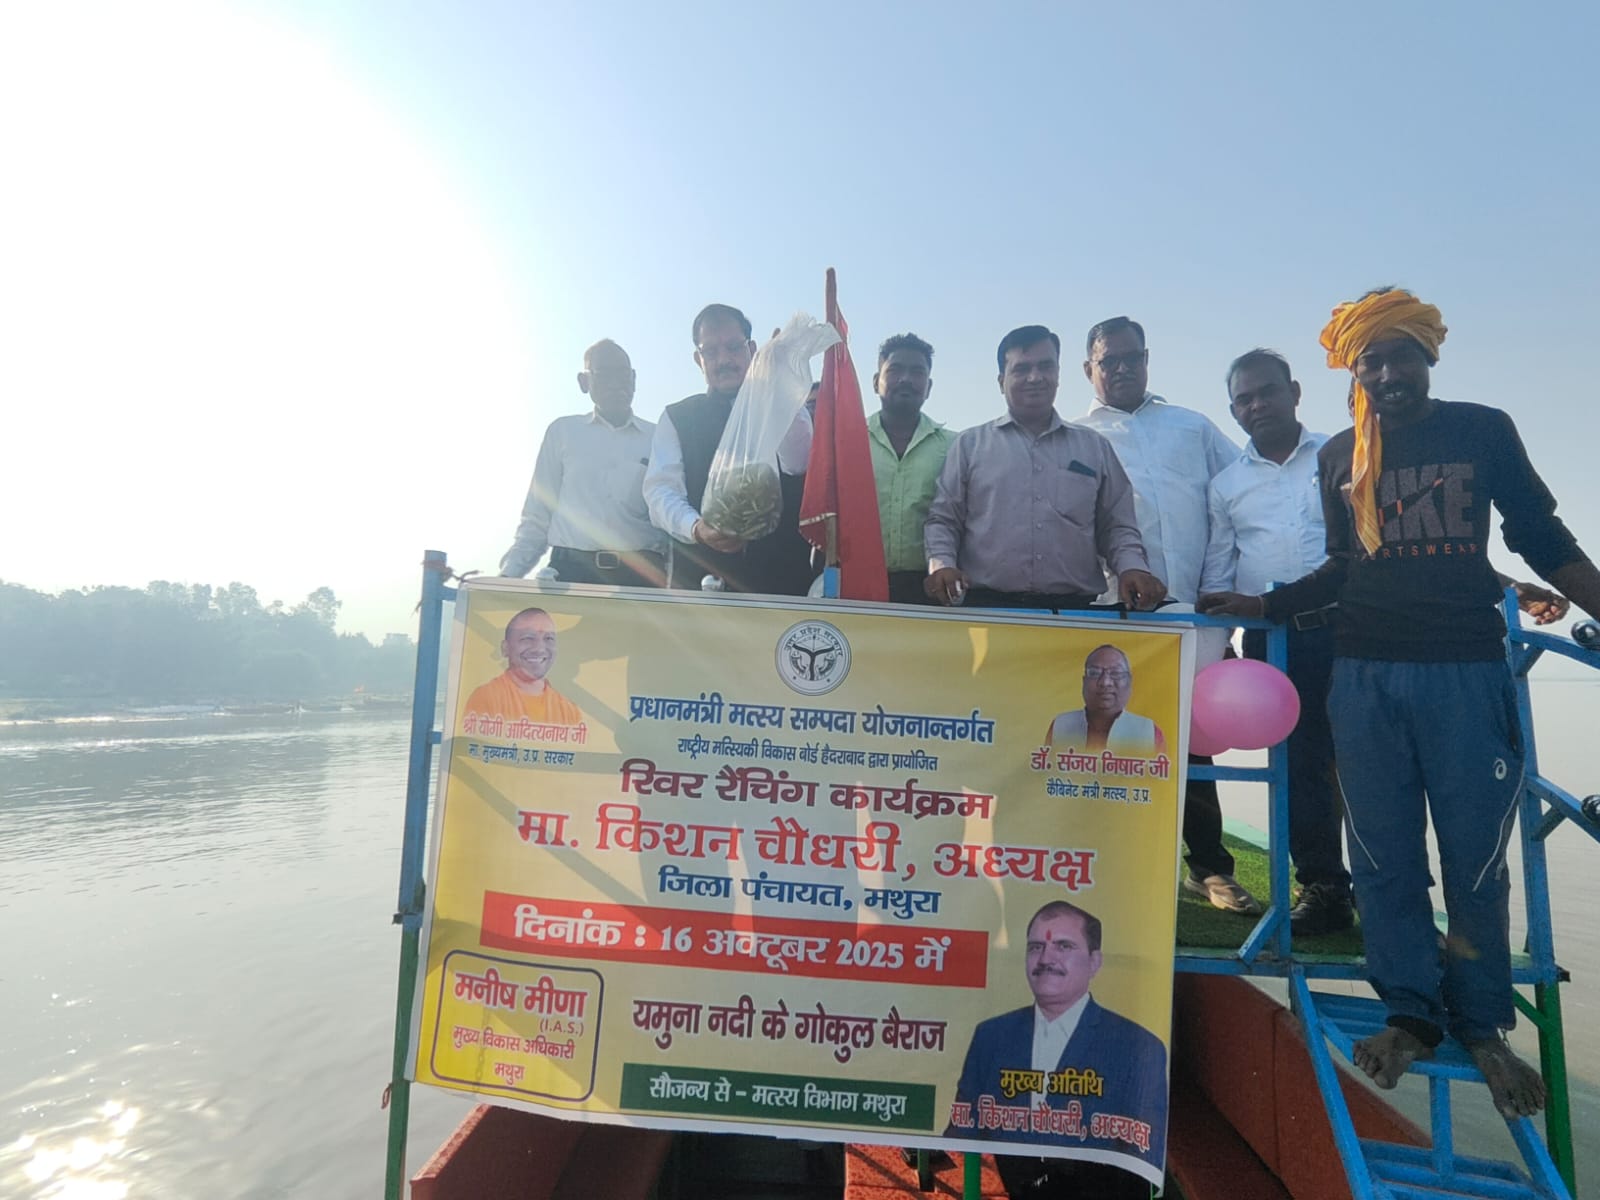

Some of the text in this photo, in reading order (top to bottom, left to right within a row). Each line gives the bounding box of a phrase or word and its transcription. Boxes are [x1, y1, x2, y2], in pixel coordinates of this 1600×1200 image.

[1379, 463, 1475, 542] IKE
[464, 713, 587, 744] श्री योगी आदित्यनाथ जी
[630, 692, 995, 743] प्रधानमंत्री मत्स्य सम्पदा योजनान्तर्गत
[544, 751, 575, 766] सरकार
[678, 734, 710, 760] राष्ट्रीय
[761, 738, 796, 761] विकास
[868, 751, 889, 768] द्वारा
[892, 749, 938, 771] प्रायोजित
[1031, 747, 1169, 778] डॉ. संजय निषाद जी
[620, 758, 994, 820] रिवर रैंचिंग कार्यक्रम
[1047, 778, 1079, 797] कैबिनेट
[1082, 781, 1099, 799] मंत्री
[518, 803, 1095, 891] मा. किशन चौधरी, अध्यक्ष
[658, 864, 942, 919] जिला पंचायत, मथुरा
[513, 903, 625, 946] दिनांक
[660, 925, 693, 952] 16
[702, 928, 830, 971] अक्टूबर
[836, 939, 904, 969] 2025
[914, 935, 952, 972] में
[454, 968, 588, 1017] मनीष मीणा
[453, 1026, 575, 1059] मुख्य विकास अधिकारी
[539, 1018, 584, 1036] (I.A.S.)
[633, 994, 947, 1063] यमुना नदी के गोकुल बैराज
[495, 1062, 524, 1084] मथुरा
[649, 1071, 711, 1101] सौजन्य
[714, 1076, 731, 1102] से
[752, 1085, 799, 1108] मत्स्य
[803, 1083, 859, 1112] विभाग
[862, 1093, 907, 1122] मथुरा
[1000, 1068, 1104, 1098] मुख्य अतिथि
[977, 1095, 1029, 1132] किशन
[1031, 1101, 1087, 1142] चौधरी,
[1091, 1113, 1151, 1152] अध्यक्ष
